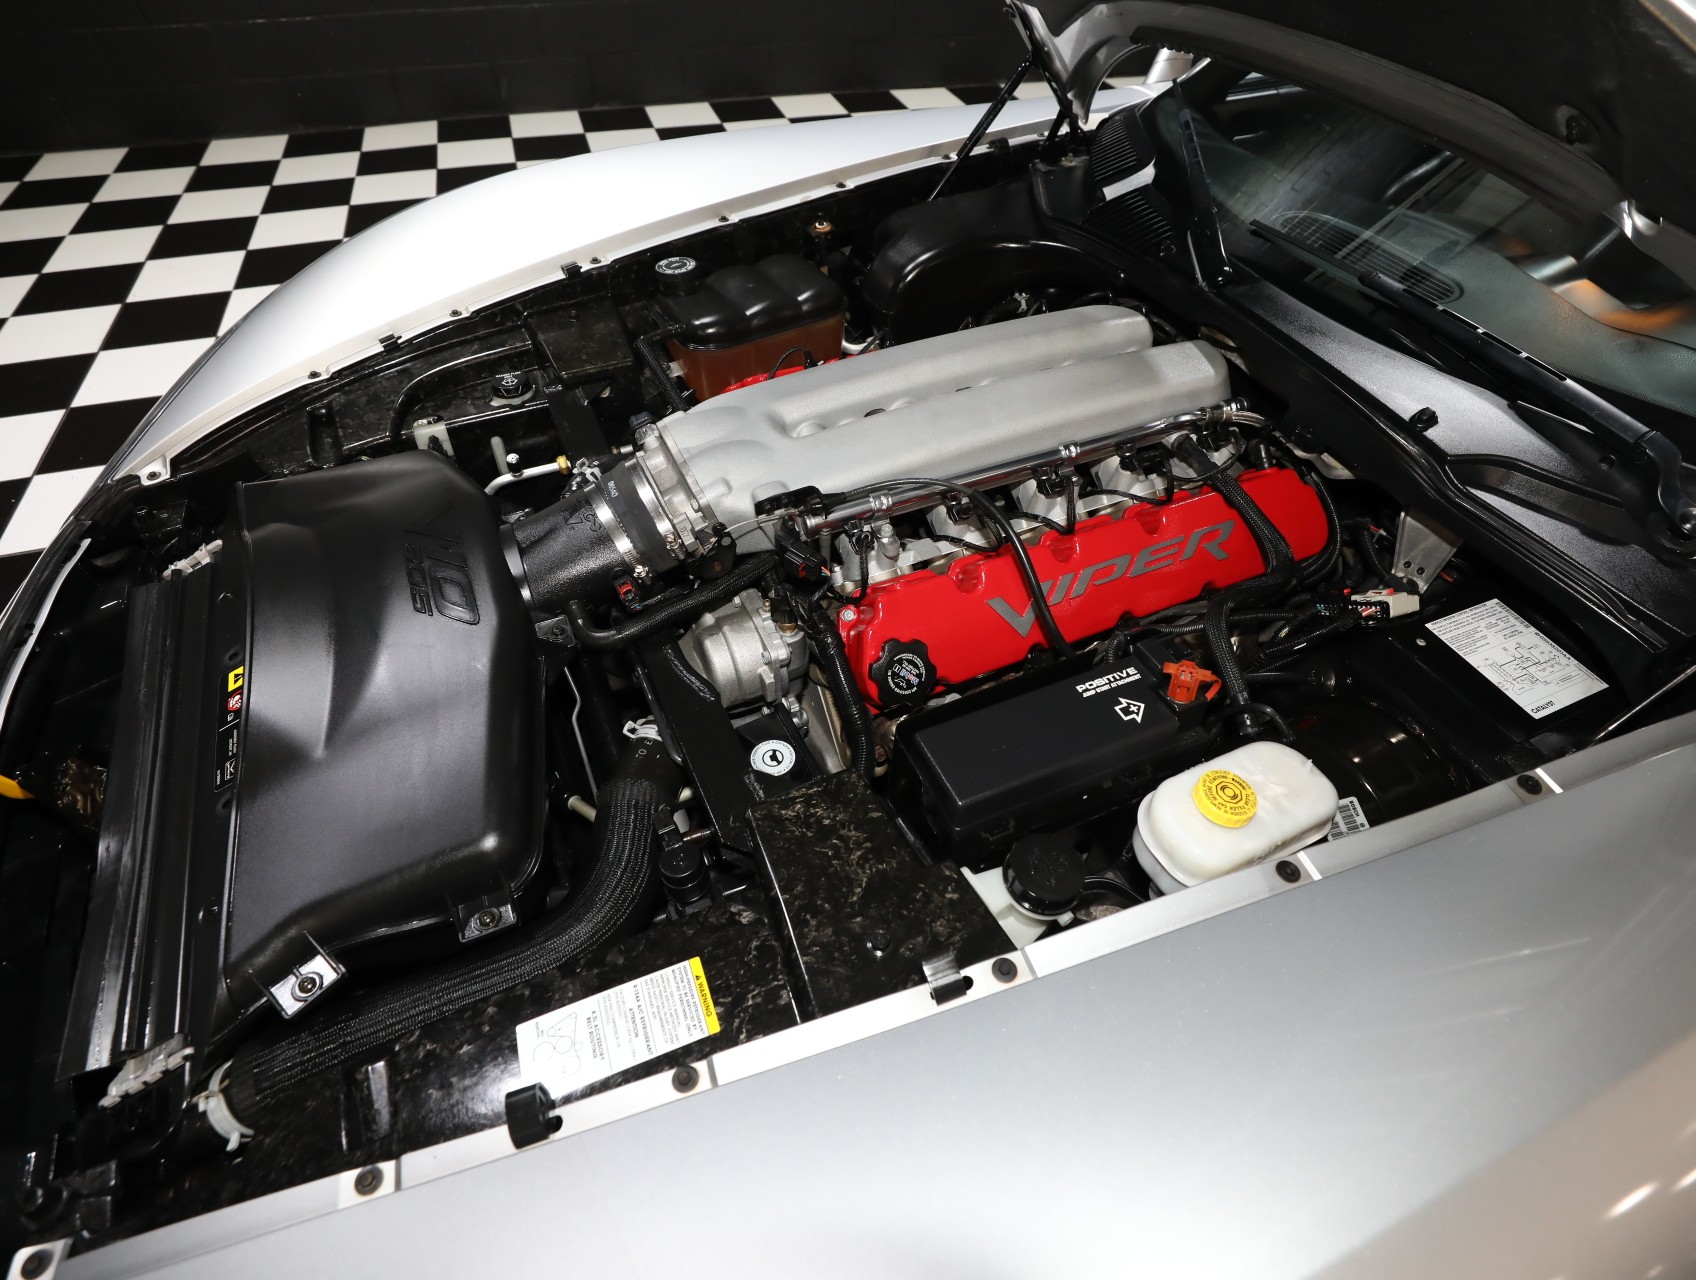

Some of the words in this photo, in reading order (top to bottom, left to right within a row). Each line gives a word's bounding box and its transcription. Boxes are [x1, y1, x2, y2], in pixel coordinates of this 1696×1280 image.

[986, 519, 1236, 638] VIPER
[1076, 667, 1138, 692] POSITIVE
[1097, 682, 1111, 693] START
[1112, 674, 1141, 688] ATTACHMENT
[1530, 699, 1555, 714] CATALYST
[1206, 785, 1217, 800] BEFORE
[1349, 800, 1359, 817] BOSCH
[671, 968, 680, 992] QUALIFIED
[678, 993, 688, 1021] PERSONNEL
[681, 964, 694, 1000] HIGH-PRESSURE
[692, 1001, 704, 1034] REFRIGERANT
[696, 981, 713, 1017] WARNING
[628, 1007, 639, 1038] ATTENTION
[685, 998, 695, 1022] SERVICED
[588, 1030, 598, 1059] ROUTING
[593, 1023, 605, 1060] ACCESSORY
[639, 1015, 653, 1055] REFRIGERANT
